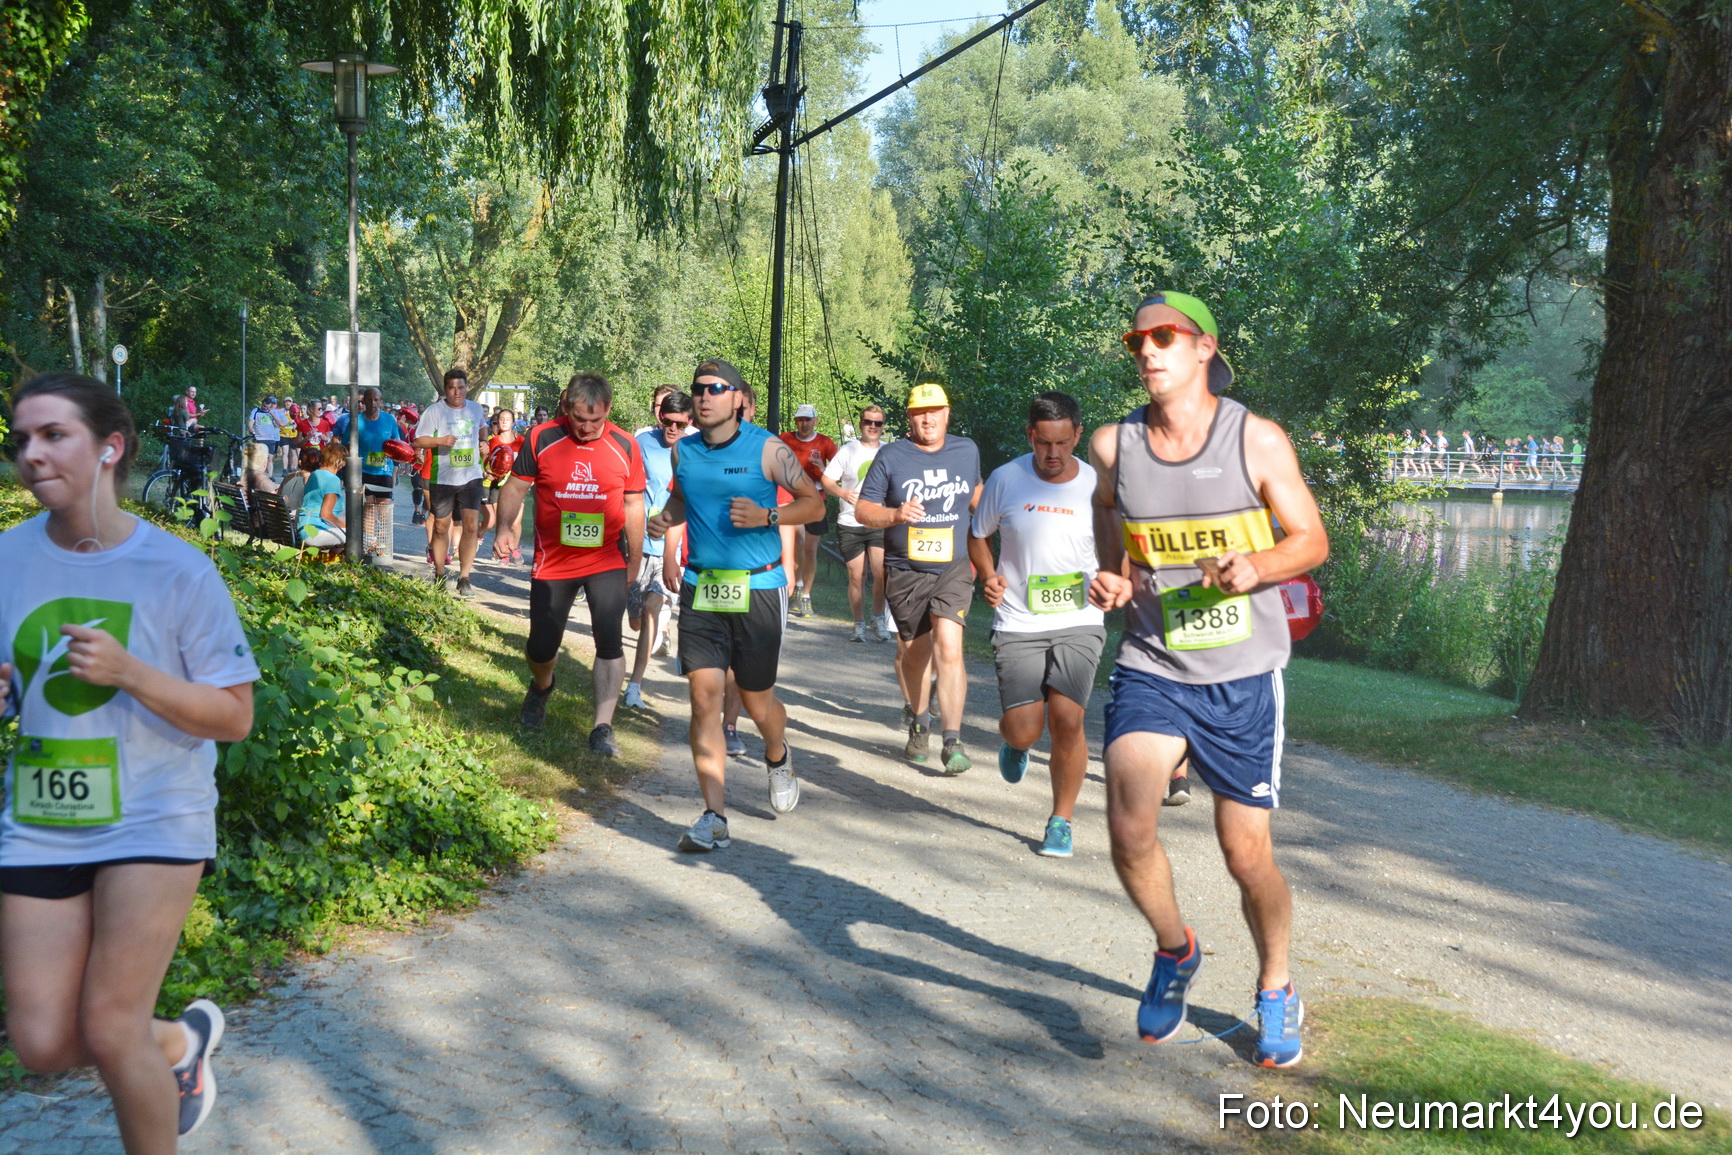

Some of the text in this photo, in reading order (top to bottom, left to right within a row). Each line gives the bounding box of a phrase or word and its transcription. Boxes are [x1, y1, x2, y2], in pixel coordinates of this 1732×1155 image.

[723, 467, 749, 475] THULE
[566, 482, 600, 493] MEYER
[901, 475, 970, 513] Burgis
[565, 523, 599, 538] 1359
[917, 540, 943, 553] 273
[702, 584, 742, 600] 1935
[1041, 588, 1073, 603] 886
[1175, 605, 1239, 631] 1388
[32, 767, 91, 801] 166
